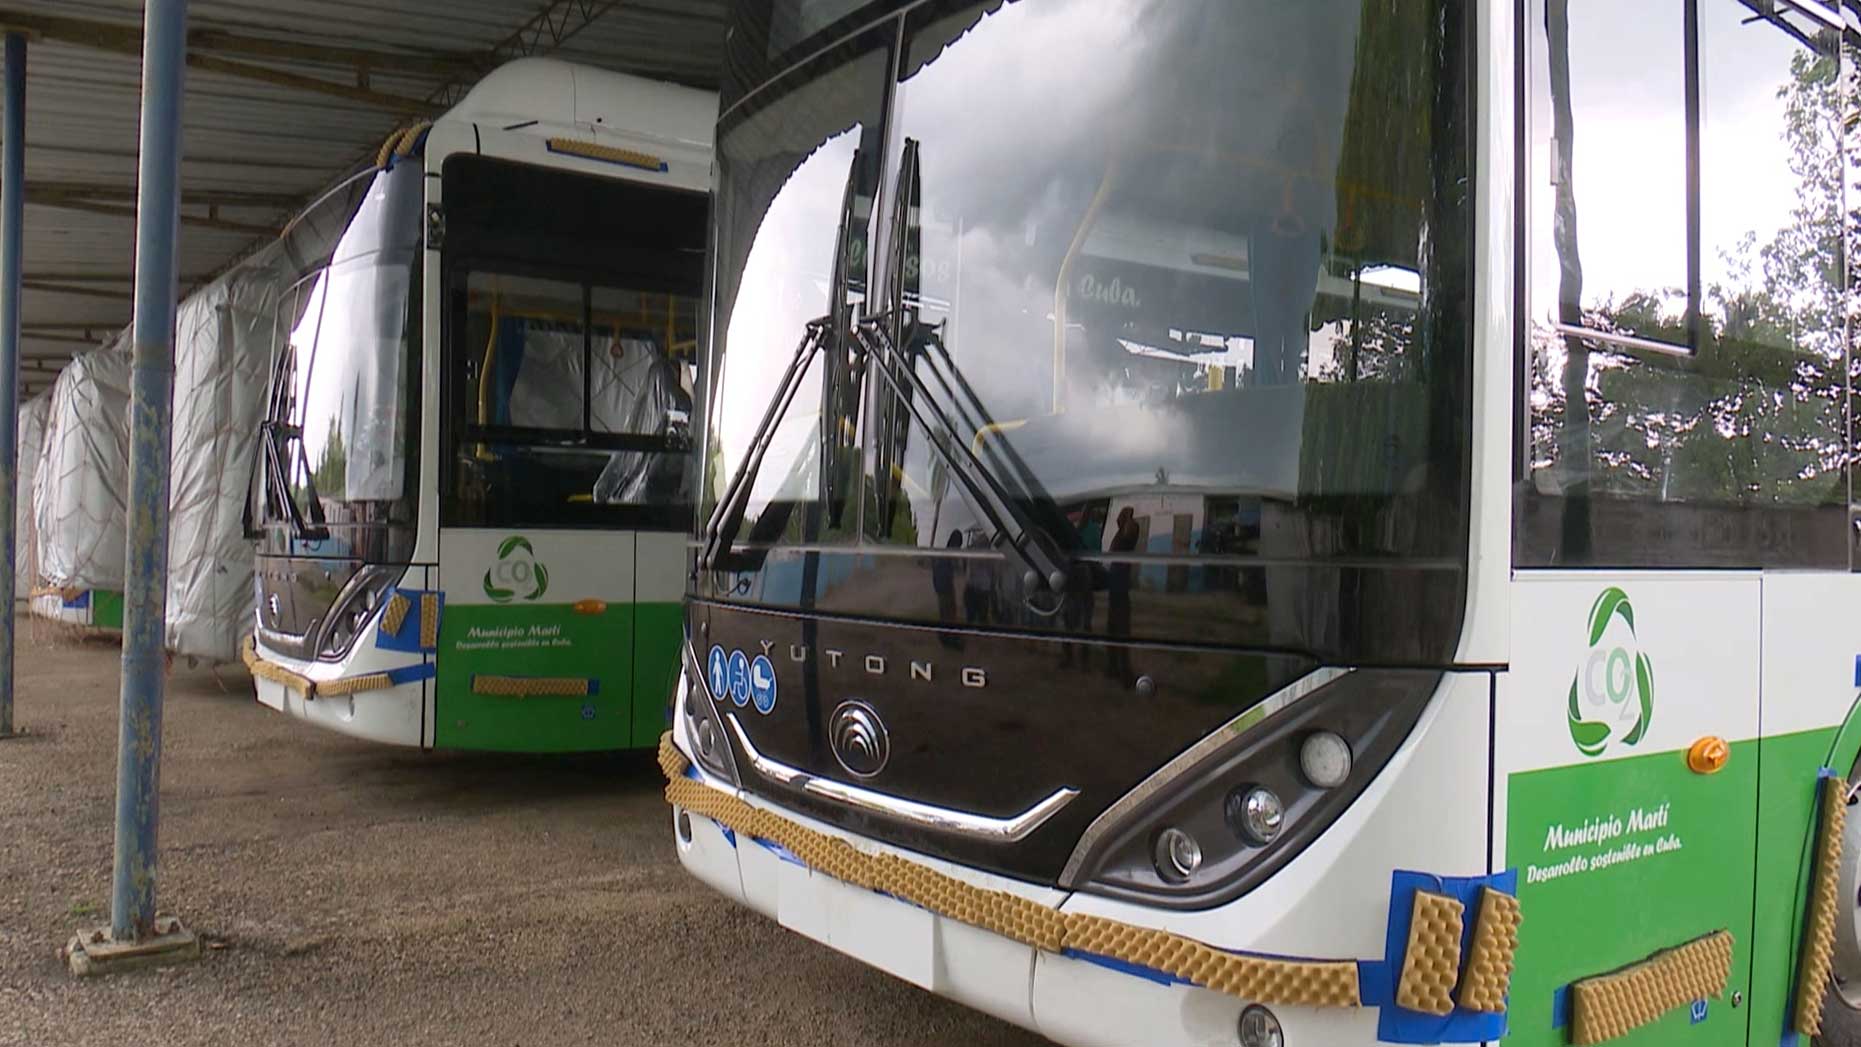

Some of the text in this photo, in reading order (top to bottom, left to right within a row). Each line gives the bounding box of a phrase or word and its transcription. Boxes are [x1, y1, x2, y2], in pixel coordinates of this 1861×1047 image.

[467, 626, 525, 639] Municipio
[760, 639, 986, 688] YUTONG
[1544, 802, 1671, 852] Municipio Martí
[1526, 833, 1682, 884] Desarrollo sostenible en Cuba.
